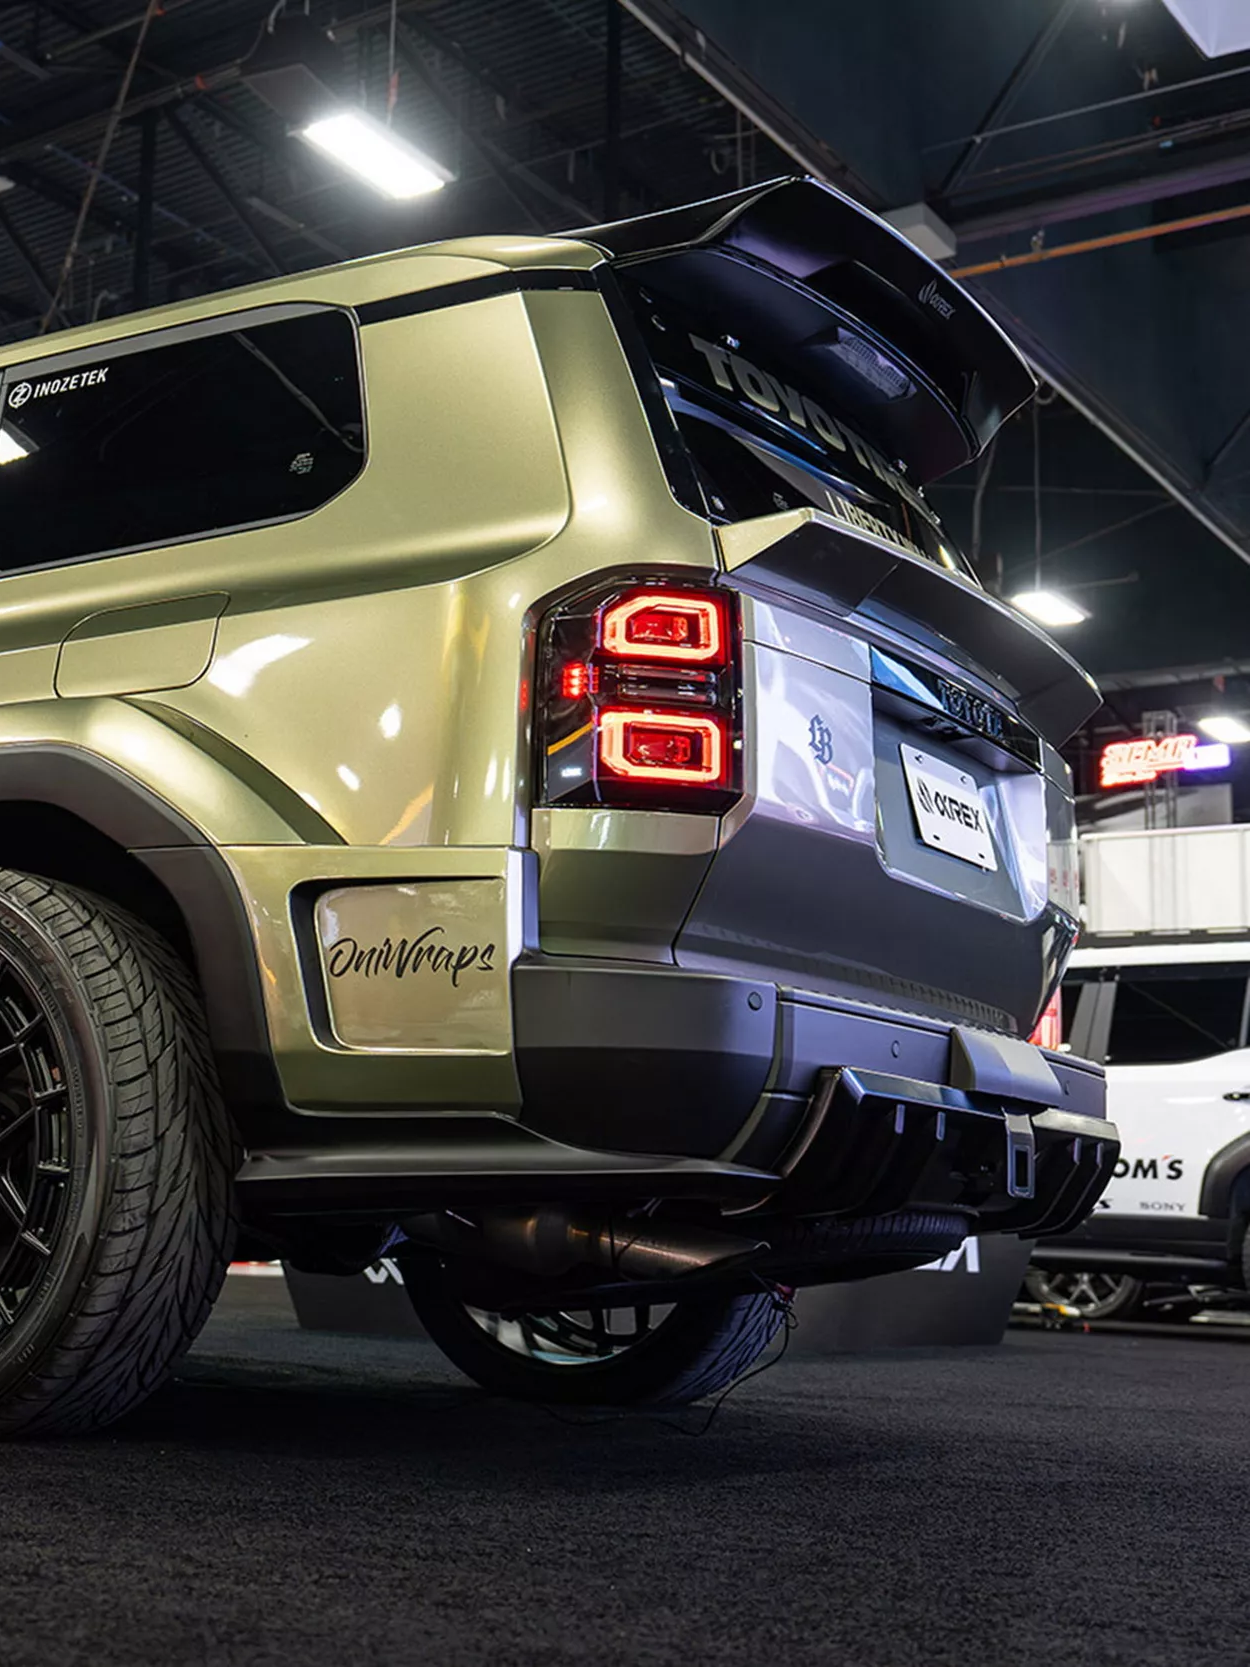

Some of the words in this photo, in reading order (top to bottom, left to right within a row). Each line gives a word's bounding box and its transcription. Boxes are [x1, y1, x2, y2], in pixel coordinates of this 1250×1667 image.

[33, 367, 109, 398] INOZETEK
[688, 333, 847, 452] TOYO
[329, 927, 496, 988] OniWraps
[1112, 1154, 1184, 1181] OM'S
[1139, 1202, 1187, 1212] SONY
